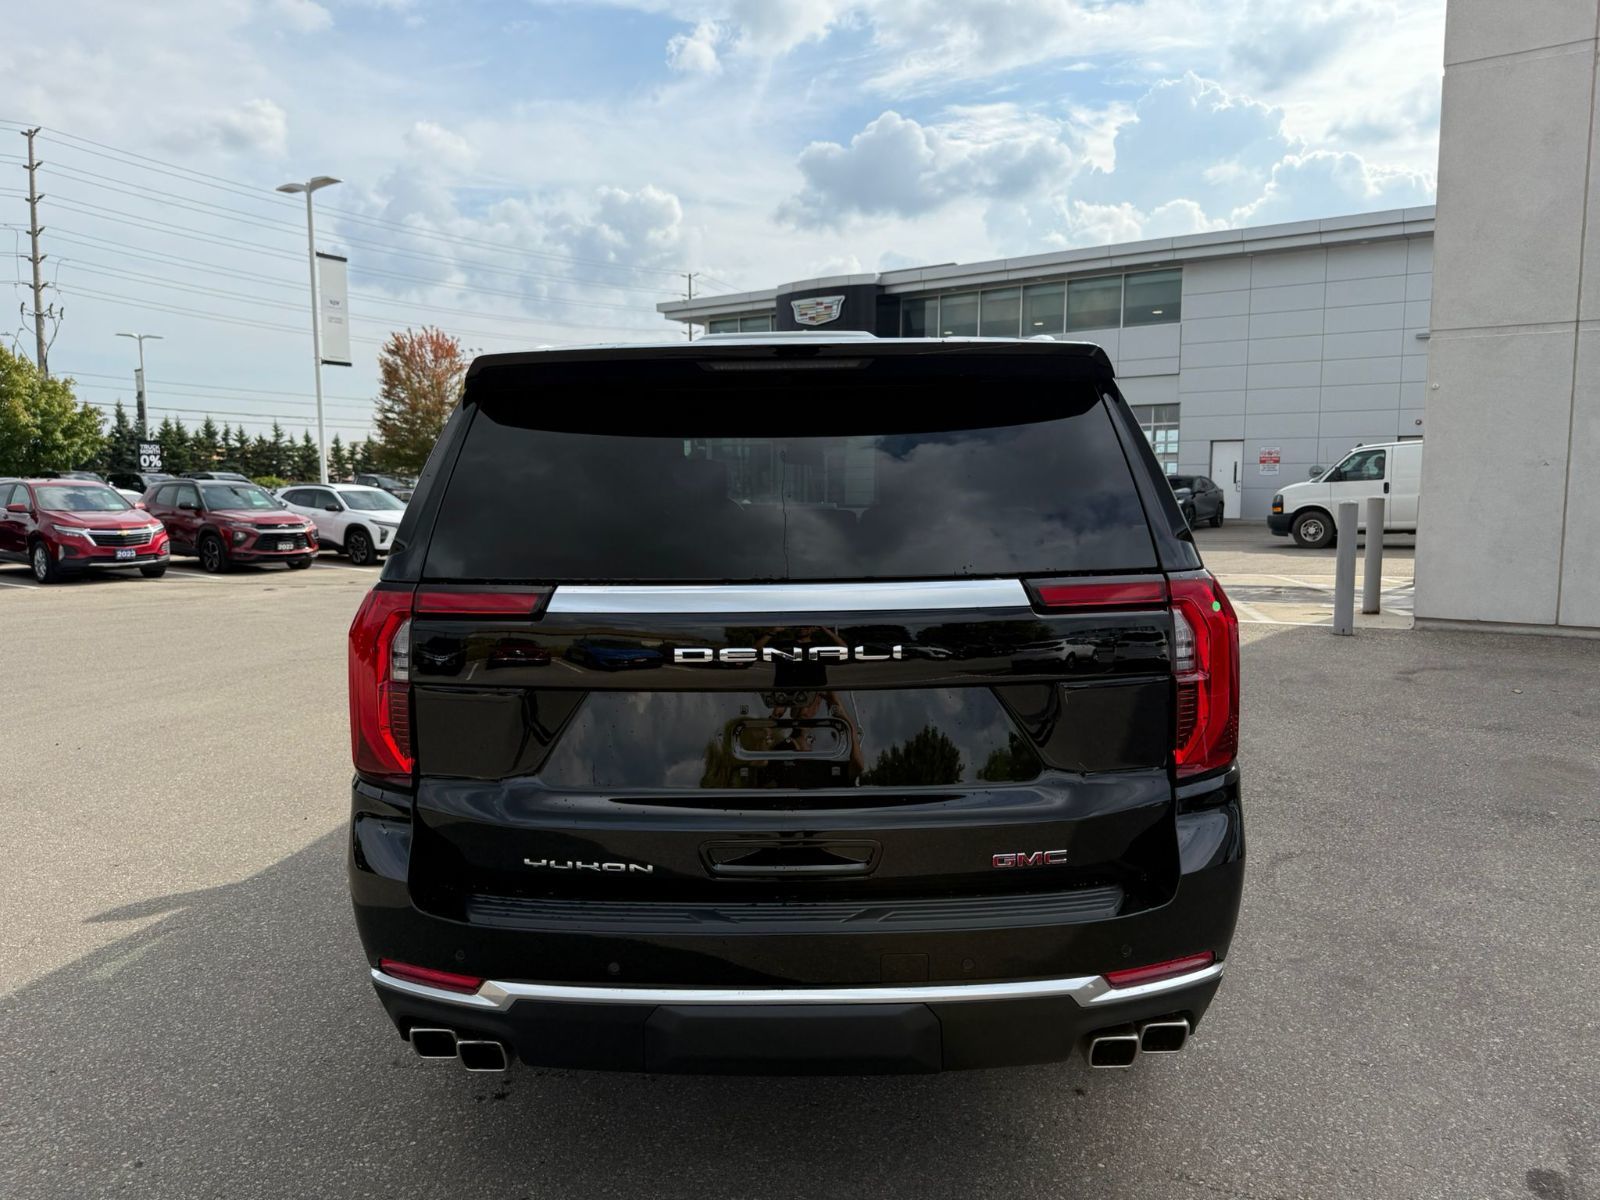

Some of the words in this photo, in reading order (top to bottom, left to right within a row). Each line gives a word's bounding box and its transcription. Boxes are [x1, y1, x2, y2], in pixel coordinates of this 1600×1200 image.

[140, 454, 162, 467] 0%
[116, 550, 136, 558] 2023
[674, 645, 902, 663] DENALI
[523, 858, 654, 873] YUKON
[992, 849, 1067, 867] GMC
